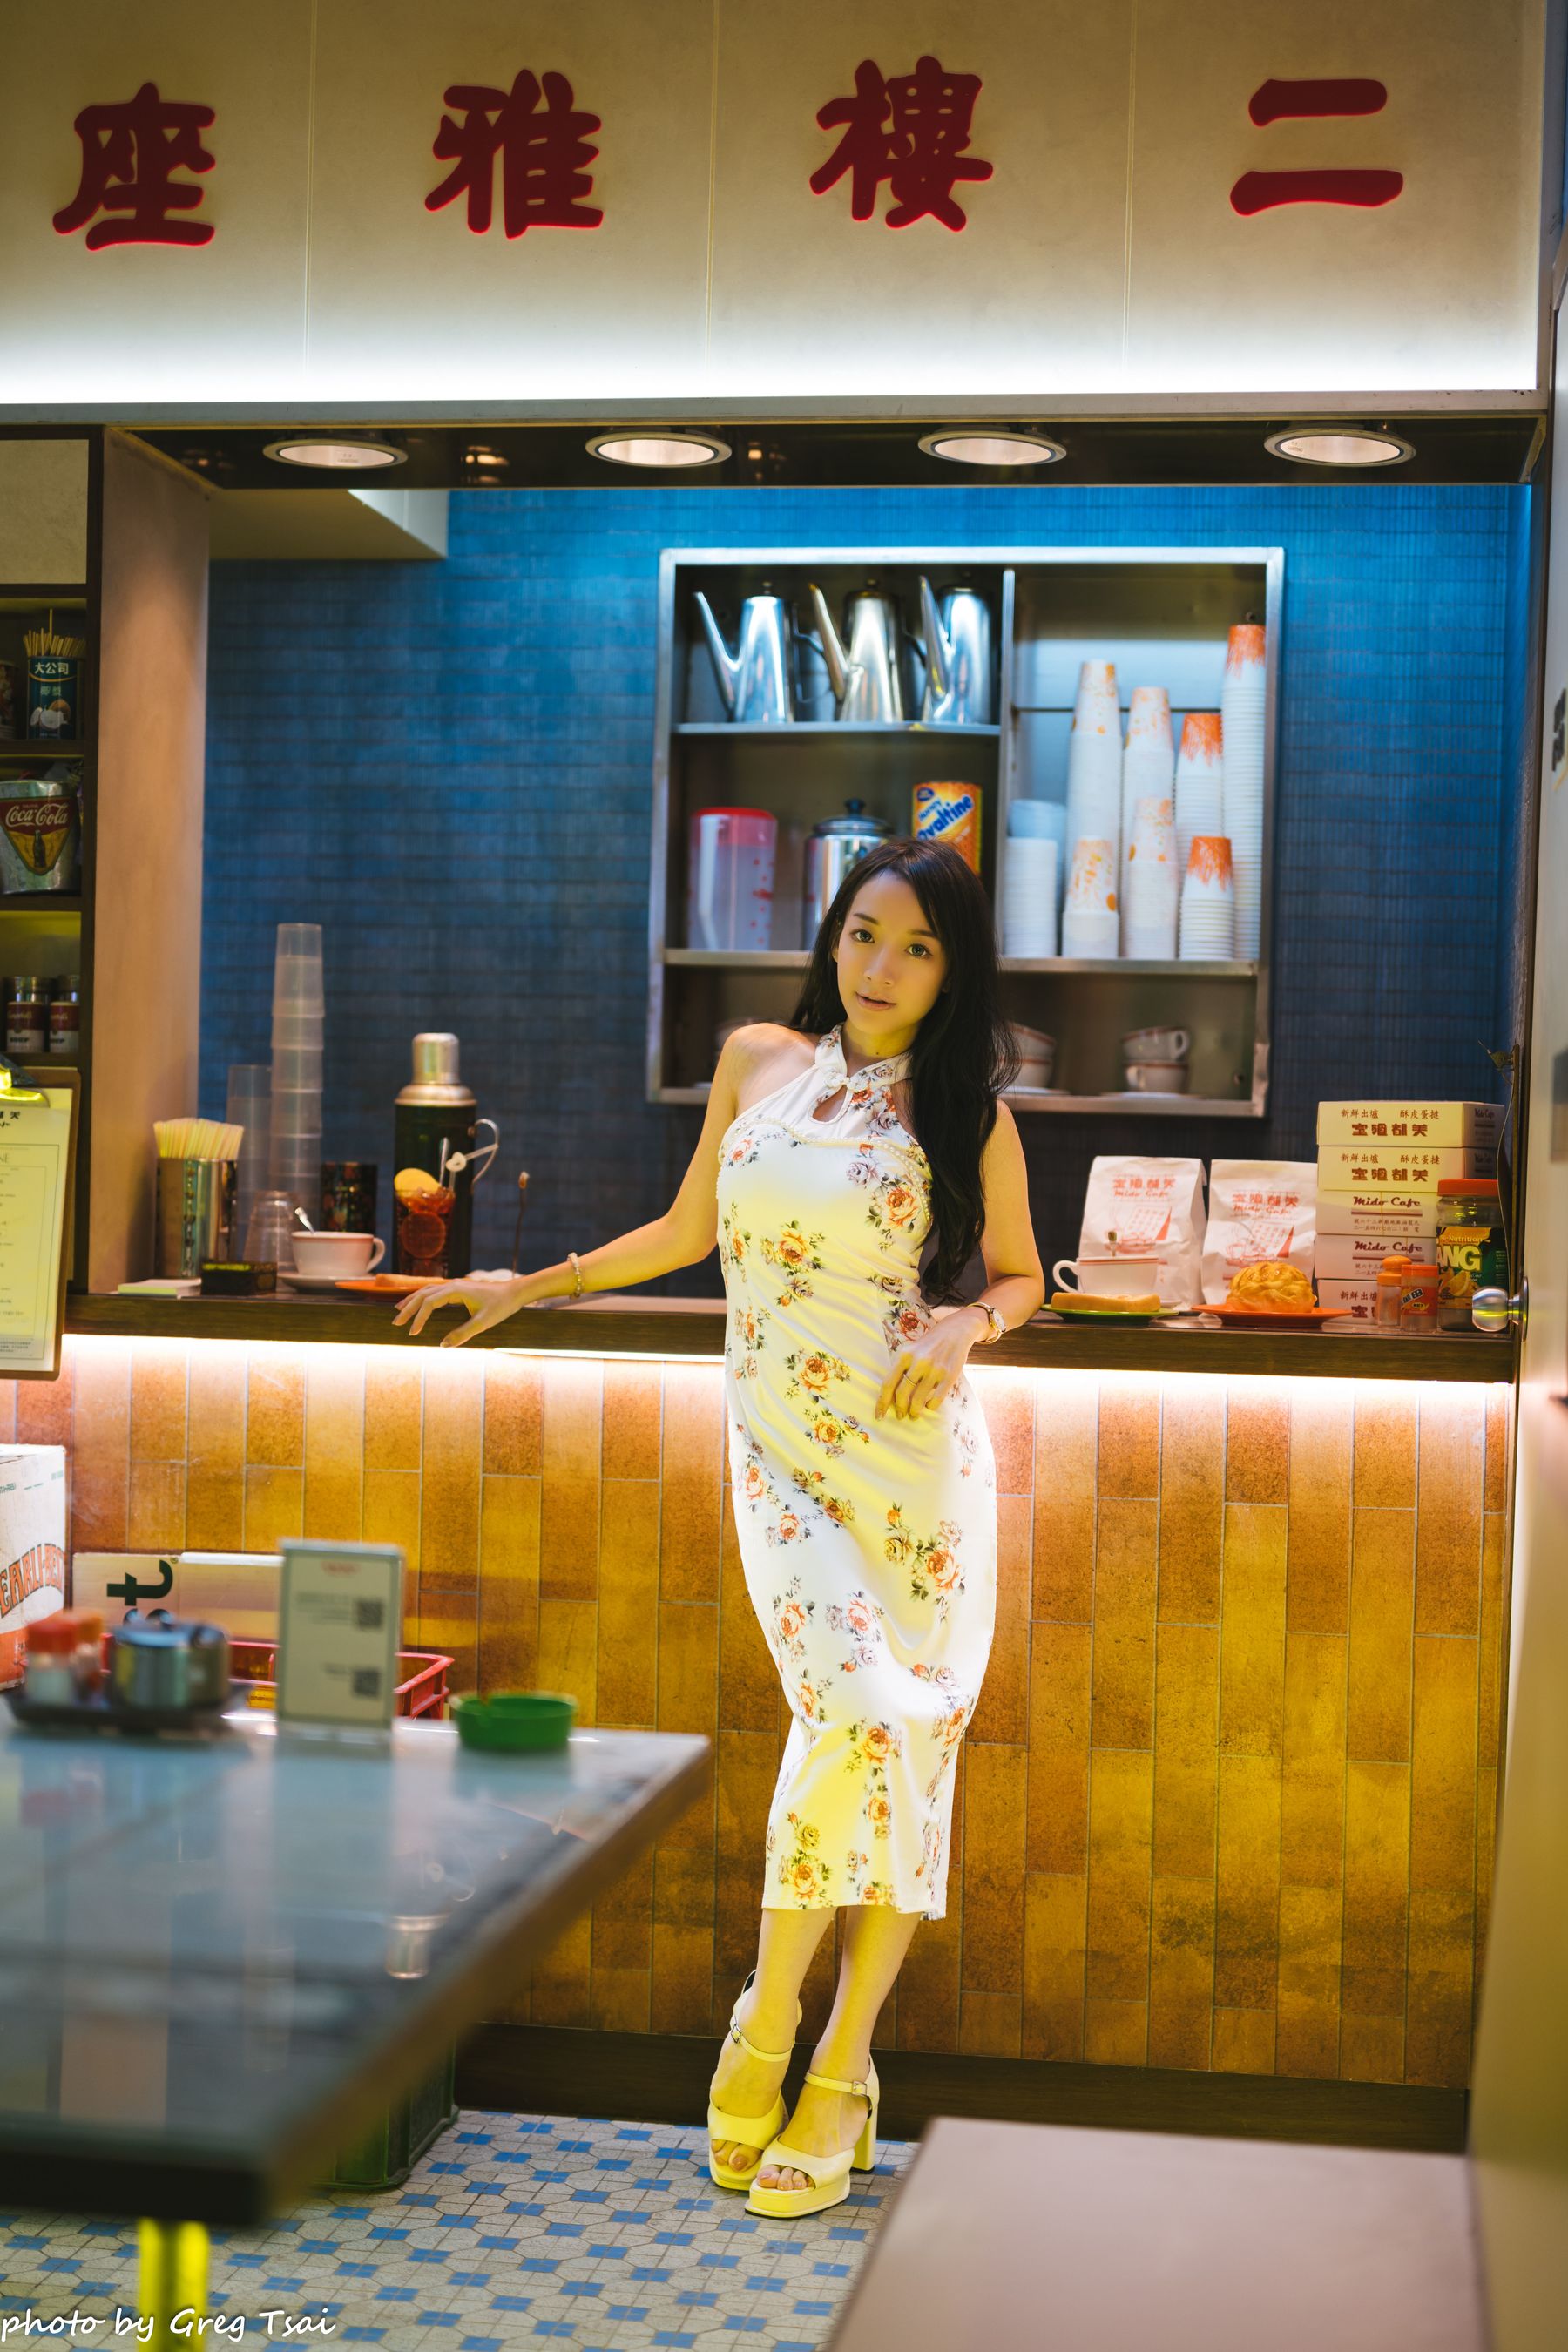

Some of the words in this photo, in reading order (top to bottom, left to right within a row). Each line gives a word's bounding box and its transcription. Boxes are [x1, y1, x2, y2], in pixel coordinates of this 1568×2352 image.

[35, 662, 69, 674] 大公司
[5, 803, 68, 828] Coca-Cola
[1353, 1196, 1389, 1206] Mido
[1391, 1197, 1421, 1208] Cafe
[1355, 1241, 1389, 1252] Mido
[1392, 1242, 1423, 1254] Cafe
[1436, 1245, 1481, 1271] ANG
